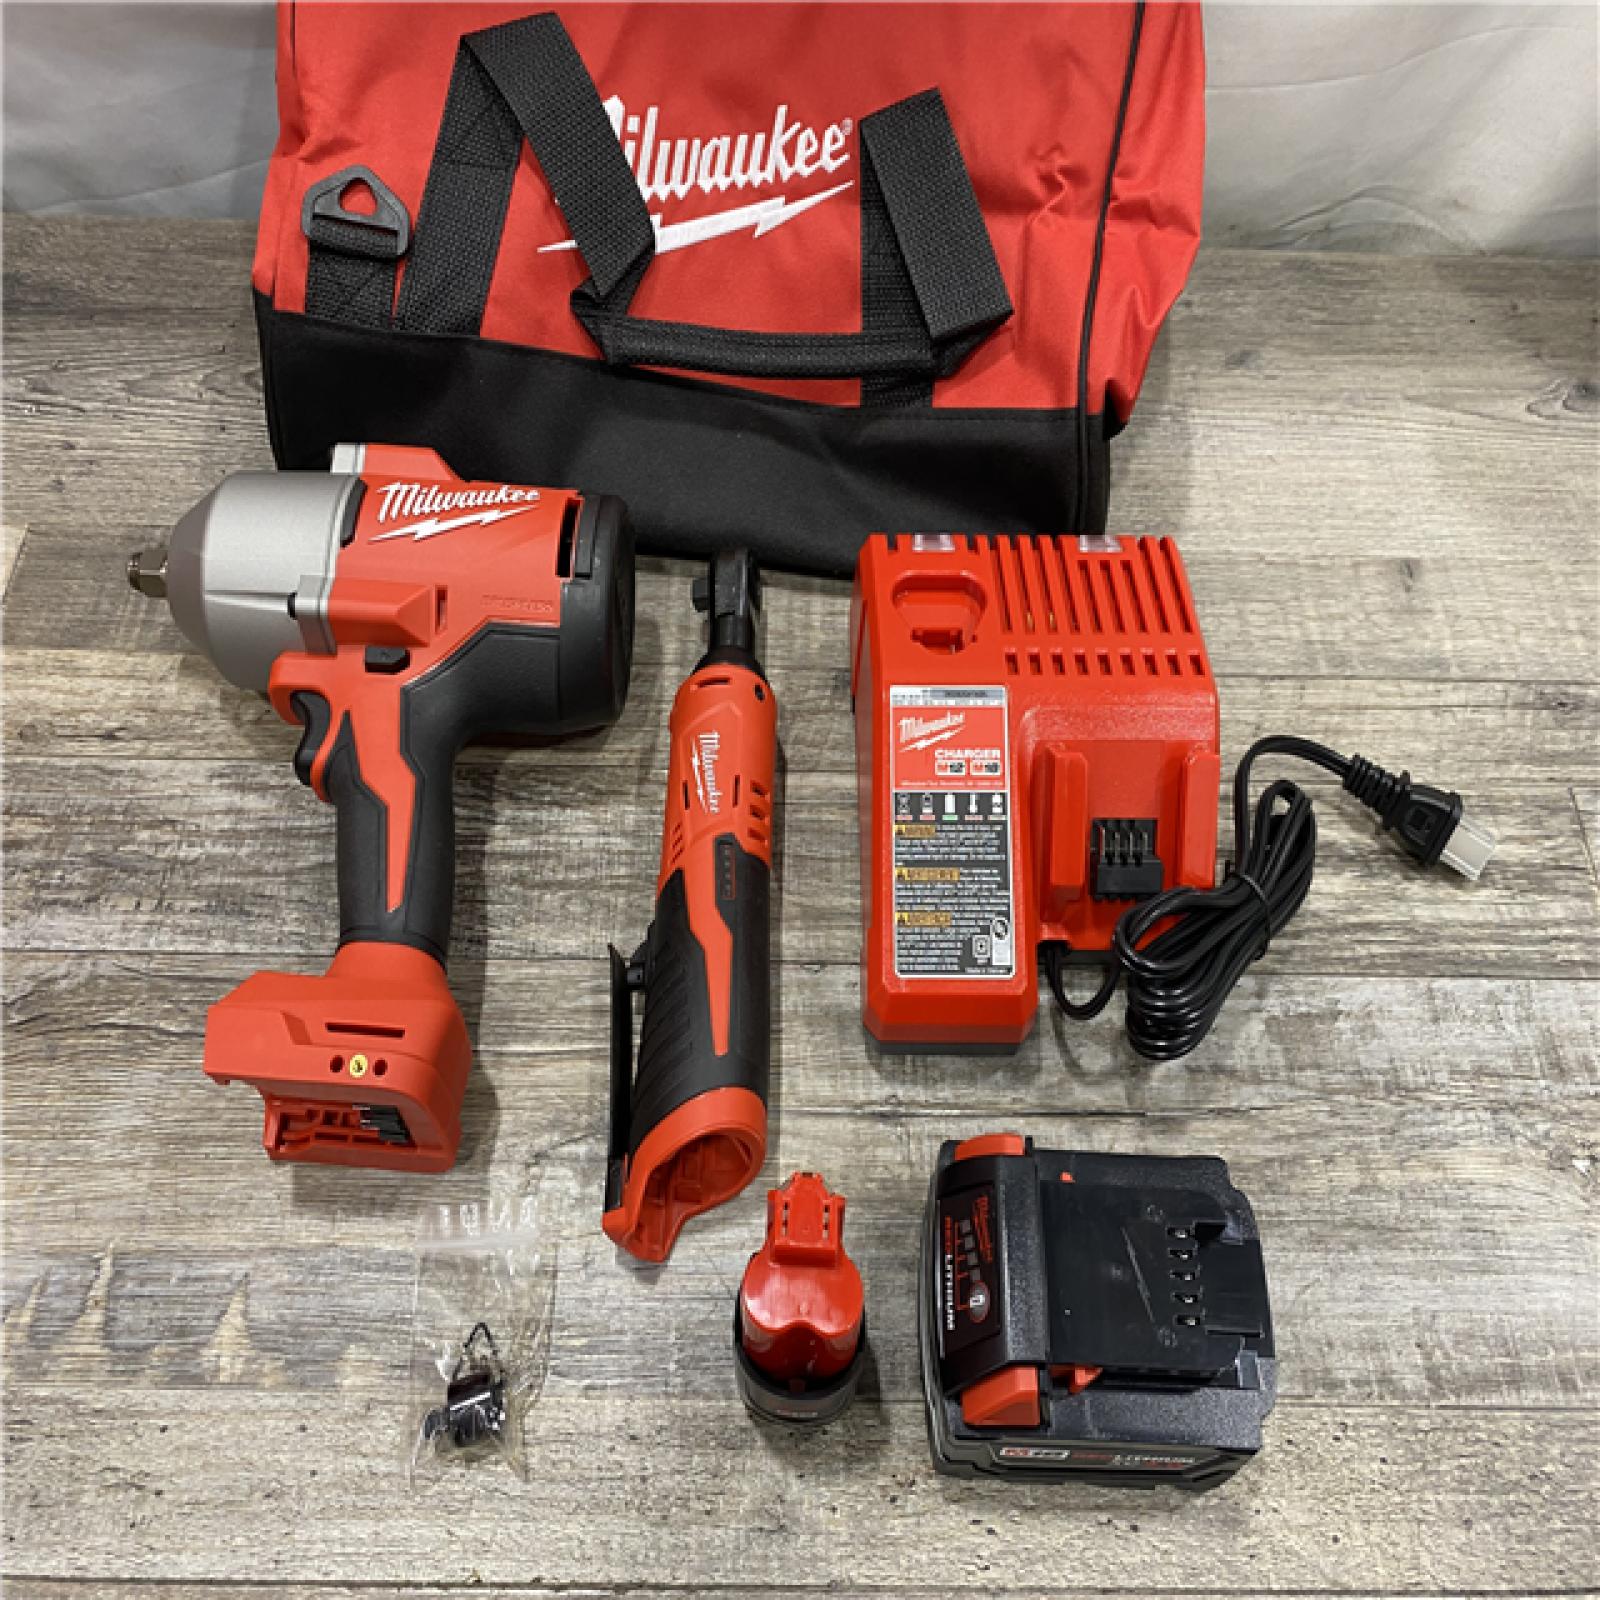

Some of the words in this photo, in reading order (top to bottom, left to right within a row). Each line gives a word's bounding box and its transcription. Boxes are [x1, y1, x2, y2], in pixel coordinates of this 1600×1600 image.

[602, 95, 852, 202] ilwaukee
[377, 481, 540, 523] Milwaukee
[699, 729, 723, 814] Milwaukee
[935, 748, 1001, 759] CHARGER
